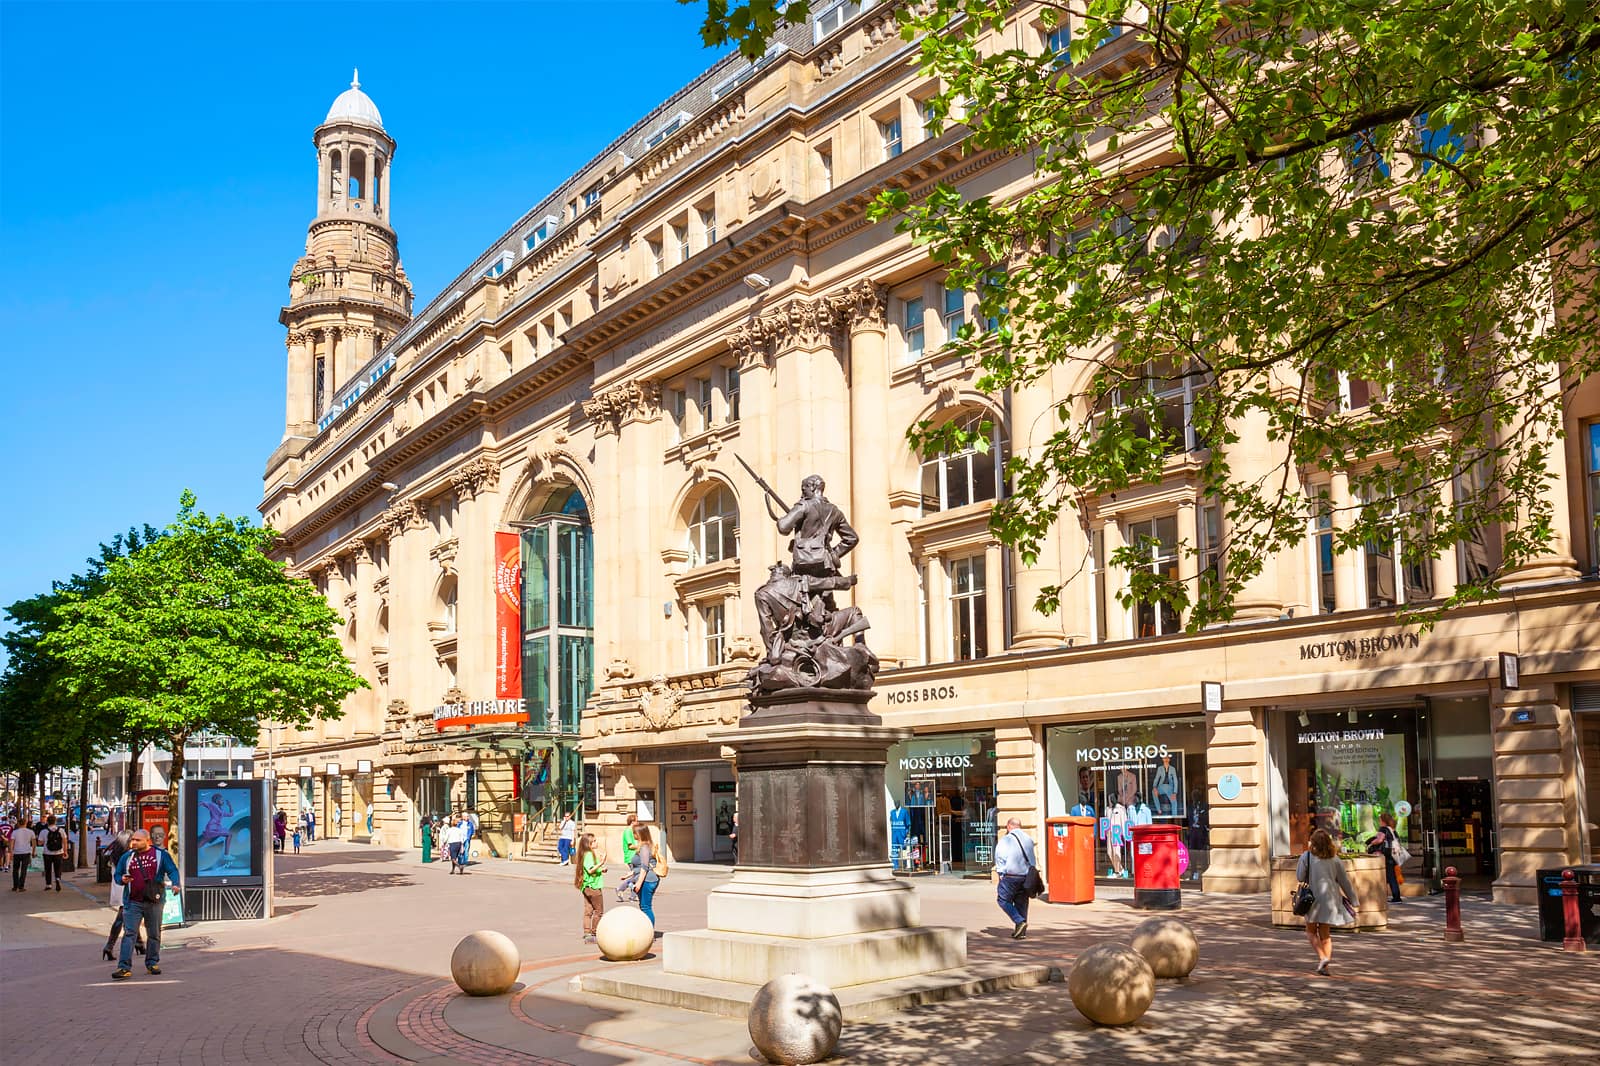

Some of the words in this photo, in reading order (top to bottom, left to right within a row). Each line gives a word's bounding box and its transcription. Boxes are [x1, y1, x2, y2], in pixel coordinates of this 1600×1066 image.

[497, 561, 507, 595] THEATRE
[1299, 640, 1357, 660] MOLTON
[1360, 632, 1419, 654] BROWN
[887, 690, 919, 705] MOSS
[922, 686, 959, 702] BROS.
[467, 698, 527, 716] THEATRE
[1297, 731, 1340, 744] MOLTON
[1343, 729, 1384, 742] BROWN
[899, 757, 933, 770] MOSS
[936, 755, 973, 769] BROS.
[1076, 747, 1119, 763] MOSS
[1124, 744, 1173, 760] BROS.
